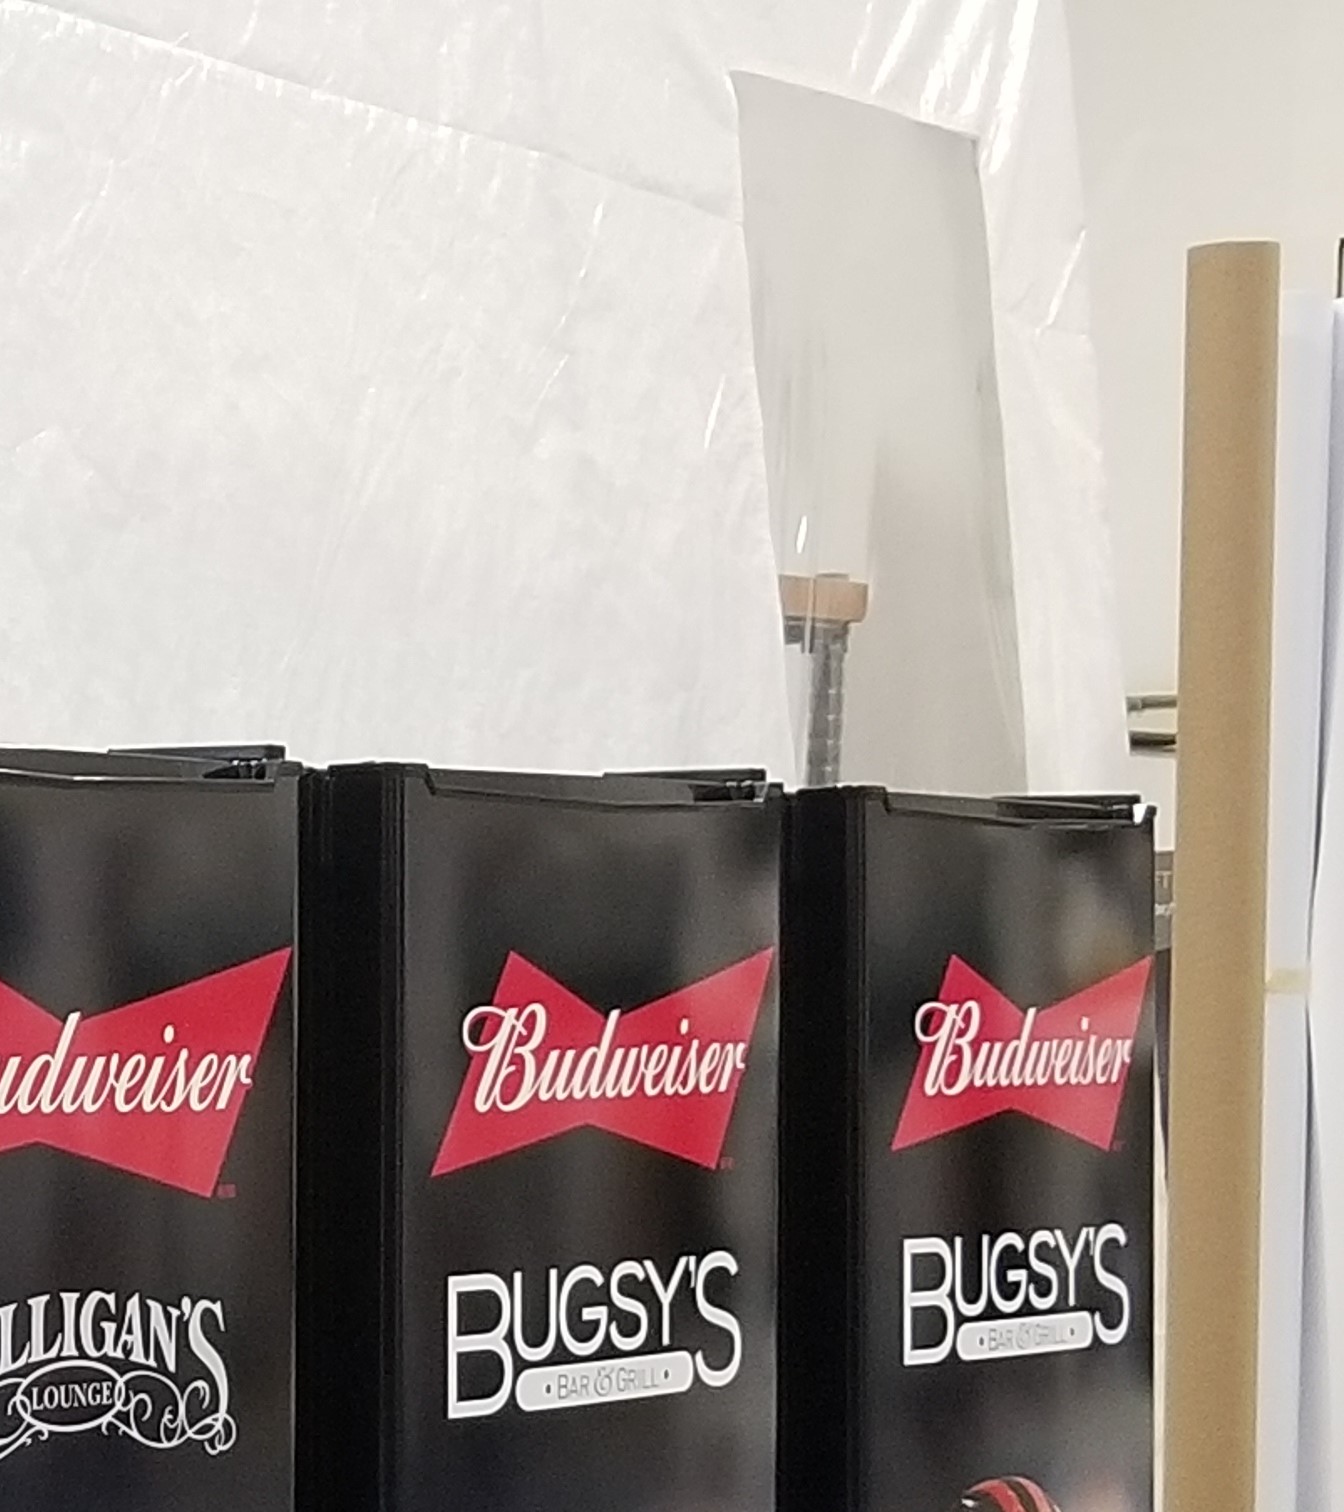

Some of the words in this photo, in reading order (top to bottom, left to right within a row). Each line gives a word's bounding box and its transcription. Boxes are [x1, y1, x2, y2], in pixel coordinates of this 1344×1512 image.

[462, 1002, 747, 1114] Budweiser
[914, 999, 1134, 1096] Budweiser
[448, 1250, 742, 1420] BUGSY'S
[902, 1223, 1130, 1367] BUGSY'S
[31, 1381, 114, 1411] LOUNGE
[557, 1374, 590, 1400] BAR
